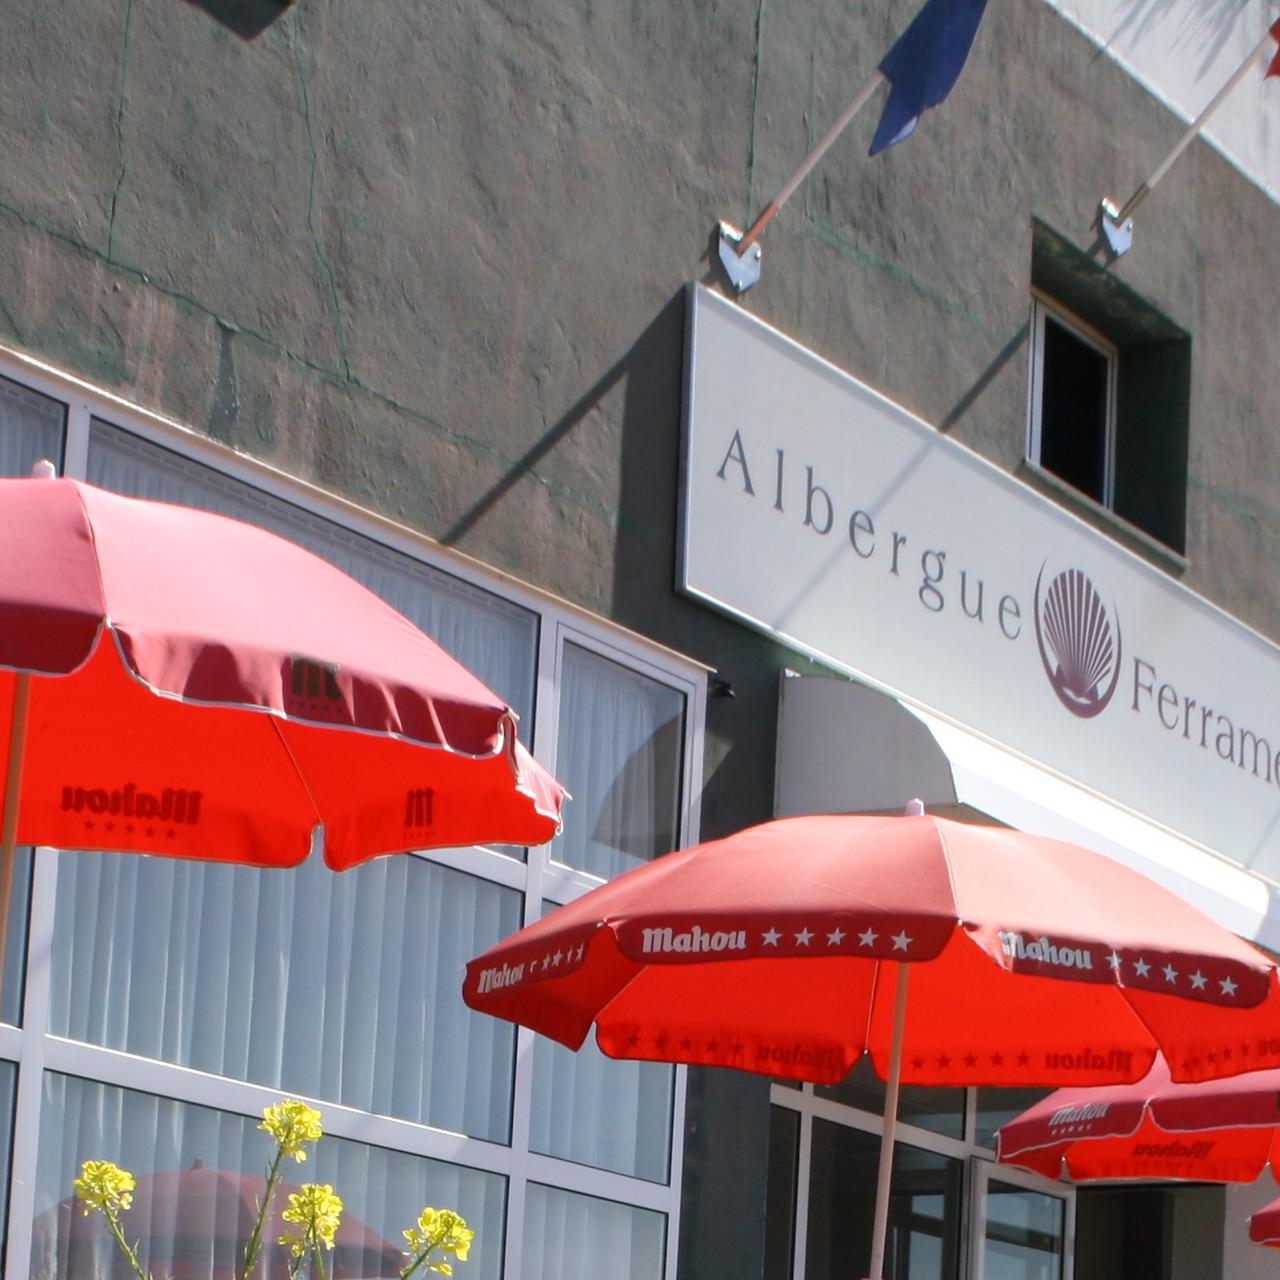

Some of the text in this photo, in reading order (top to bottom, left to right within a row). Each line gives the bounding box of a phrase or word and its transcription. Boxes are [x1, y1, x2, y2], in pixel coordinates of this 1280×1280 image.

[716, 429, 1021, 640] Albergue
[642, 925, 746, 953] Mahou
[998, 930, 1093, 969] Mahou
[477, 961, 524, 993] Mahou
[1050, 1103, 1108, 1126] Mahou
